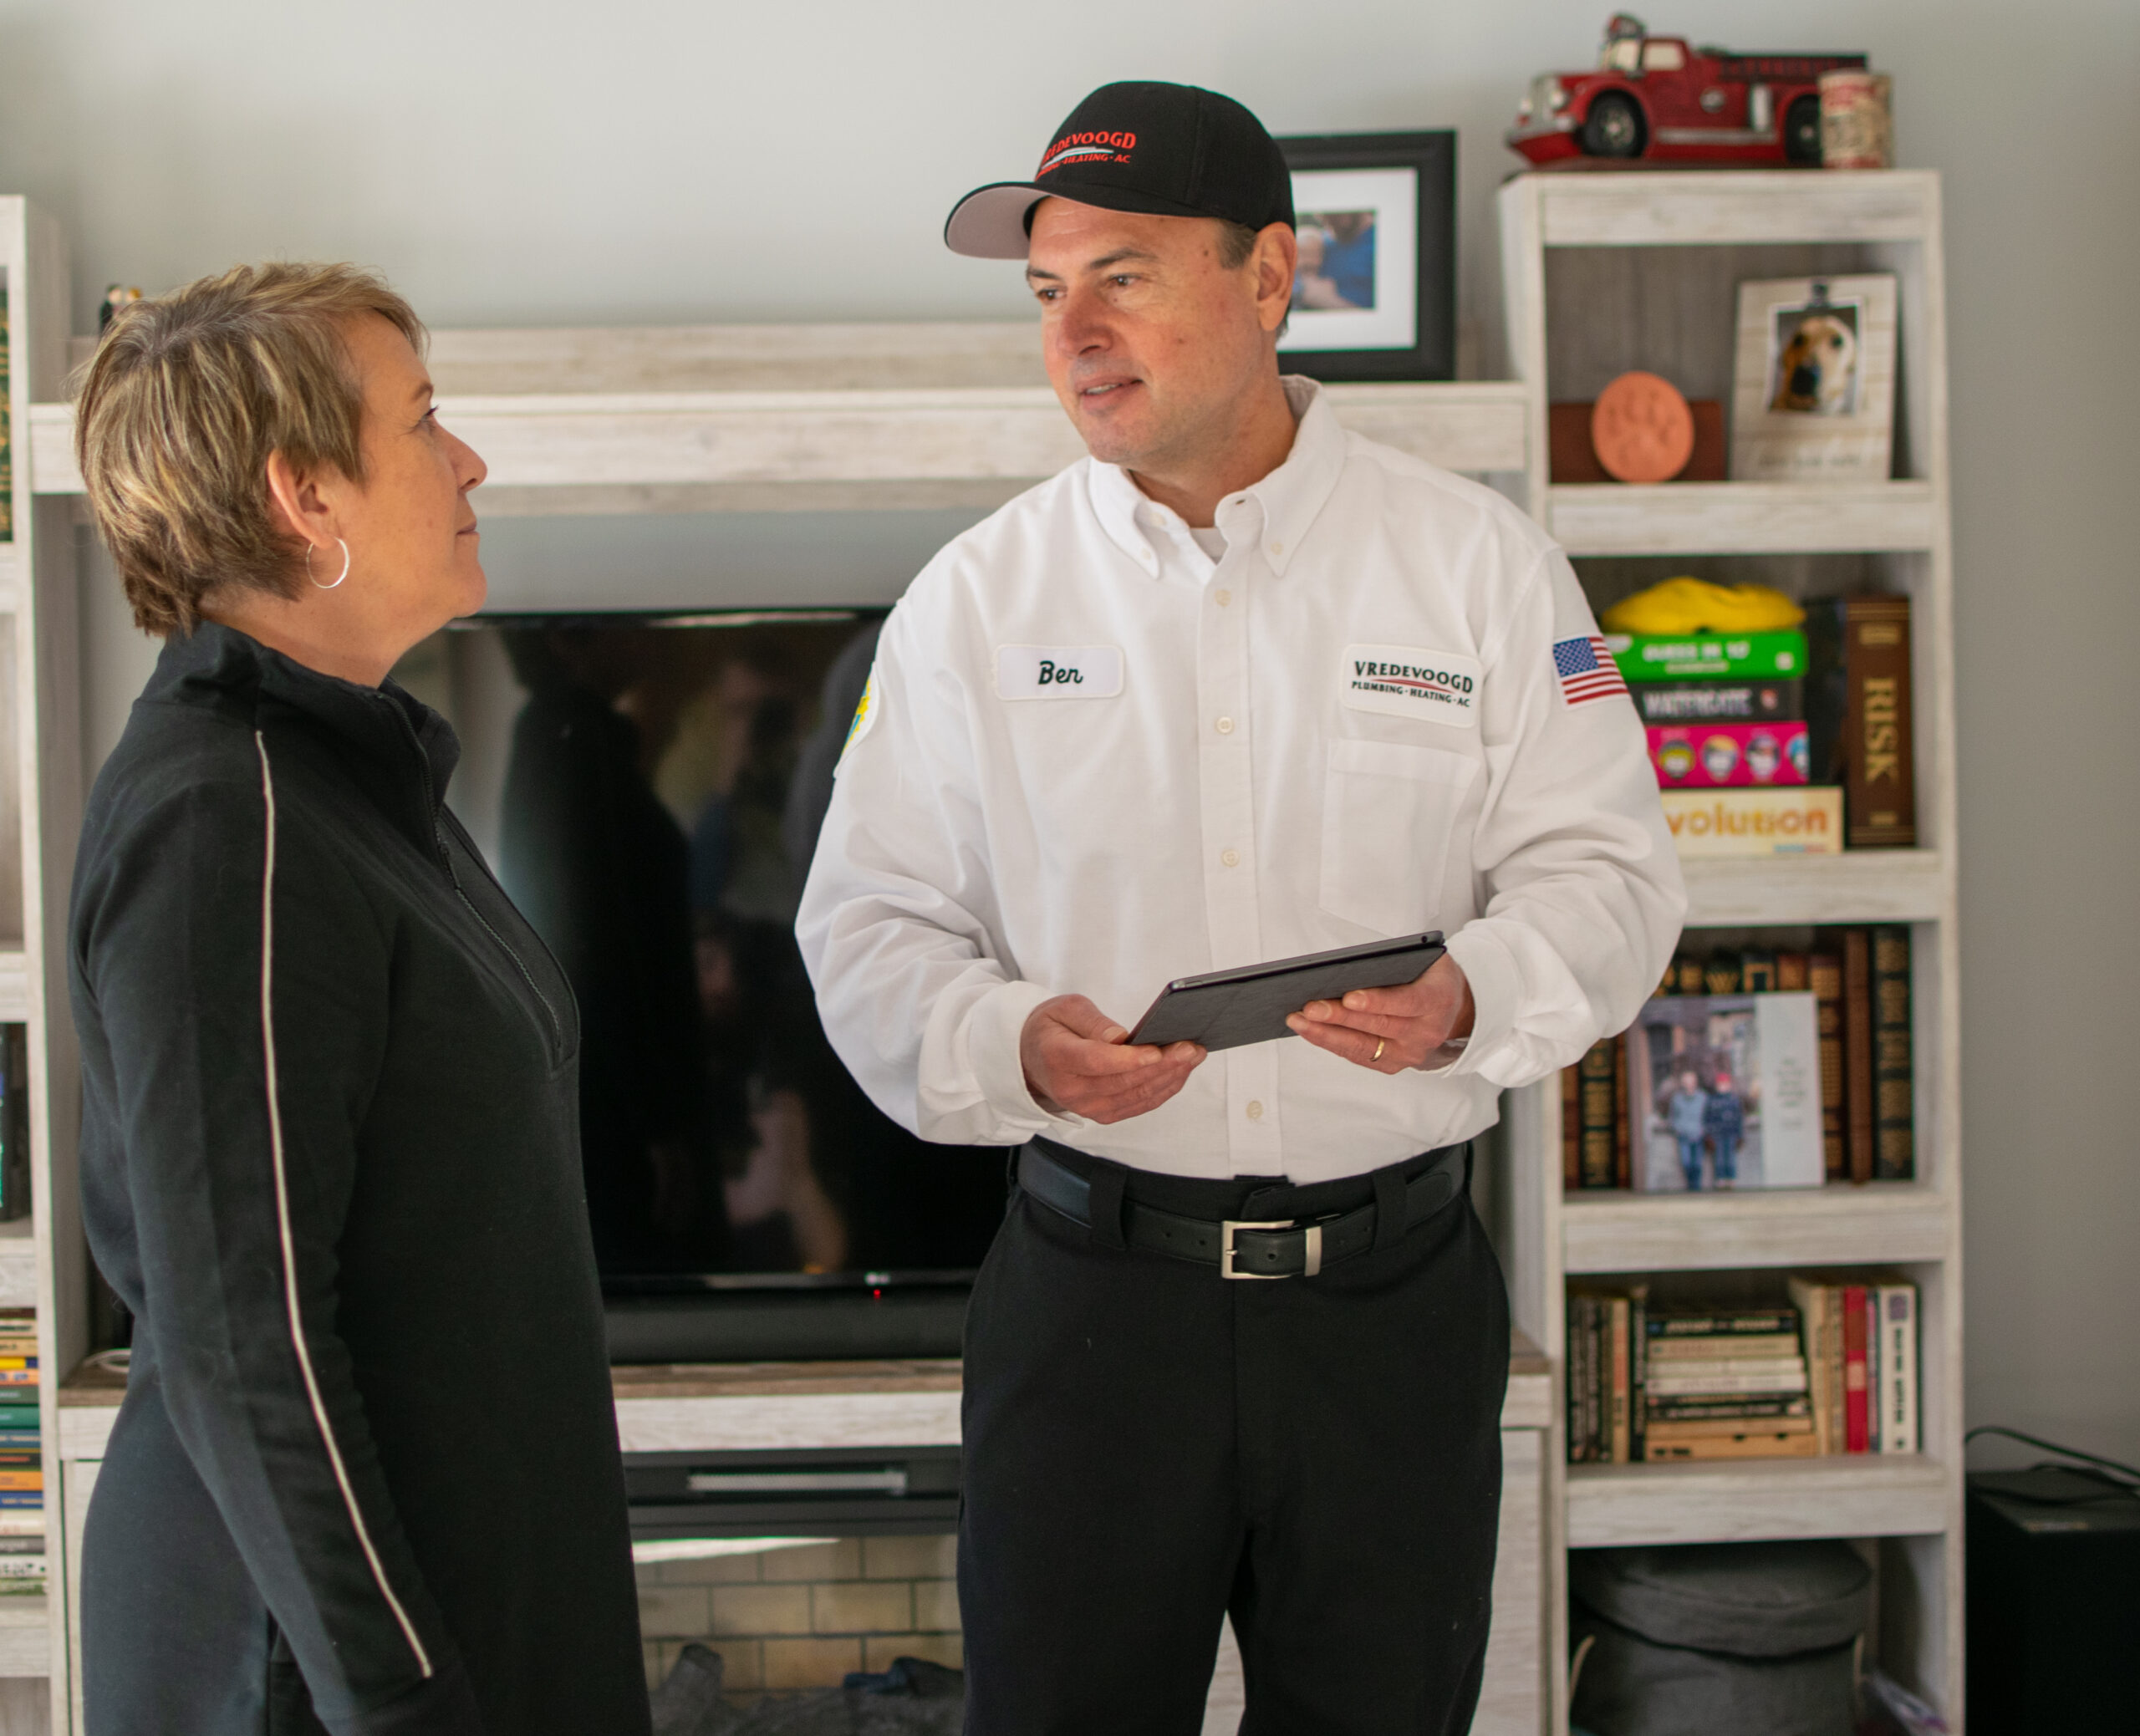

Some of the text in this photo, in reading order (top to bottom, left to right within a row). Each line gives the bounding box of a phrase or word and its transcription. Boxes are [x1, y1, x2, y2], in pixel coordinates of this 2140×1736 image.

[1114, 154, 1131, 164] AC
[1038, 660, 1083, 685] Ben
[1354, 660, 1473, 694] VREDEVOOGD
[1352, 681, 1470, 707] PLUMBING HEATING AC
[1863, 678, 1899, 784] RISK
